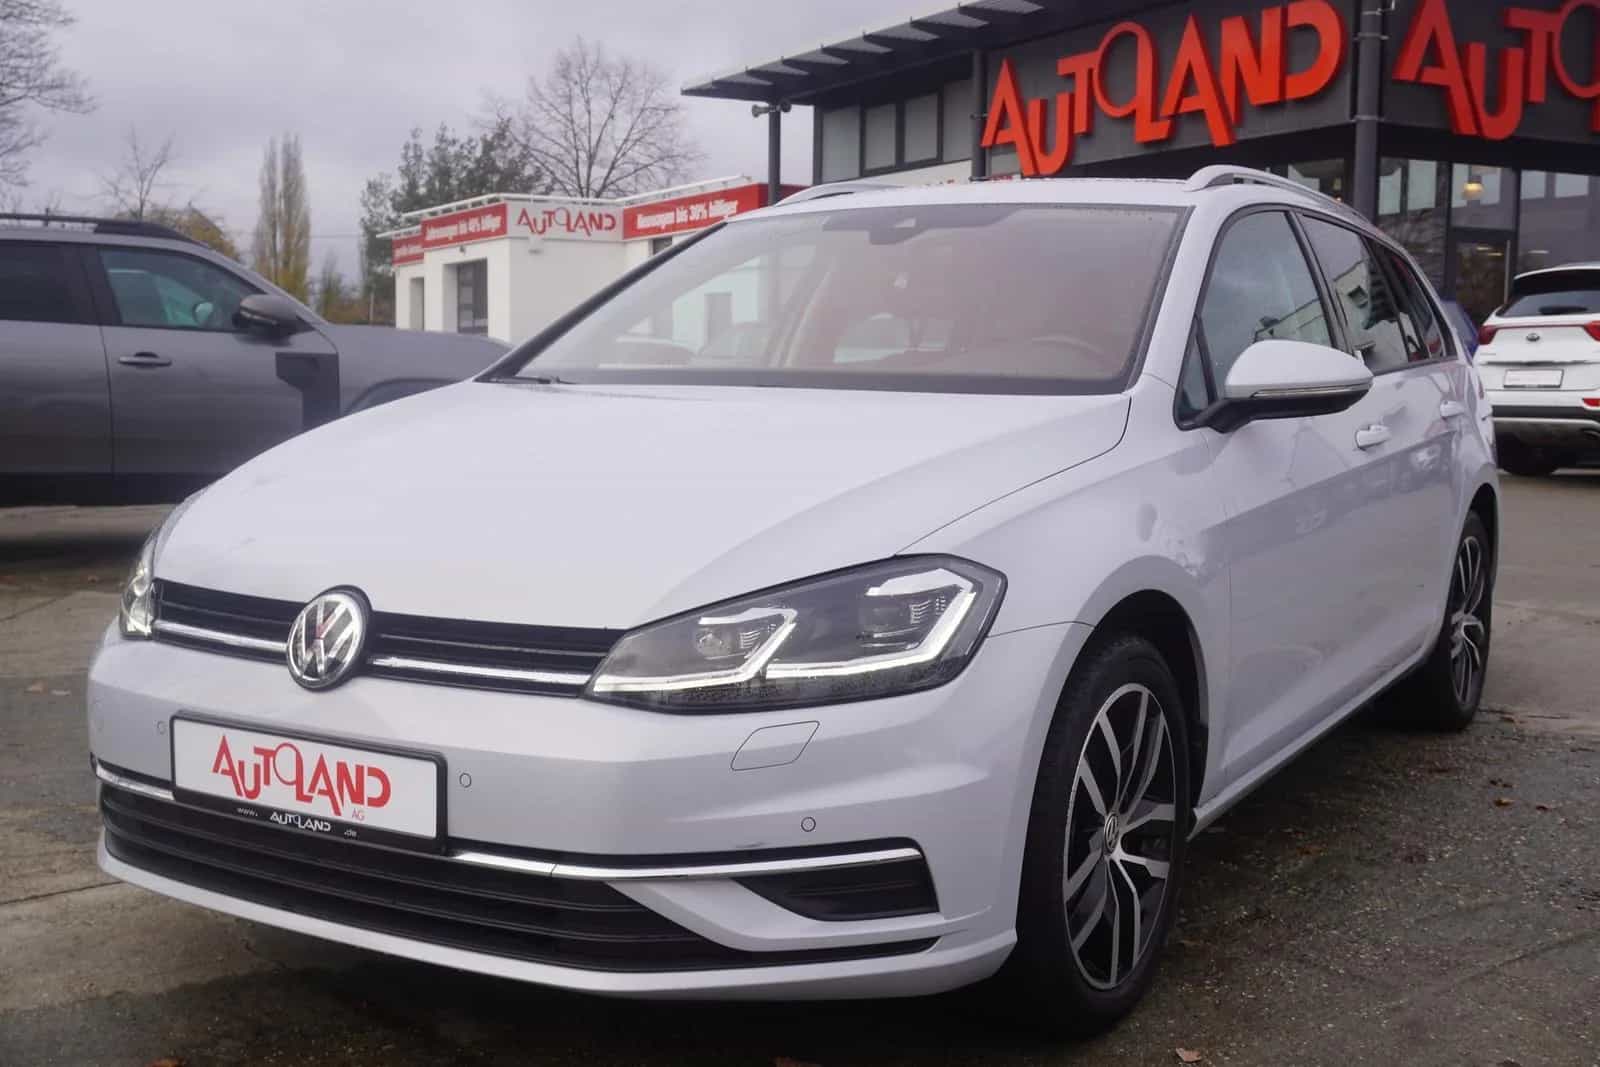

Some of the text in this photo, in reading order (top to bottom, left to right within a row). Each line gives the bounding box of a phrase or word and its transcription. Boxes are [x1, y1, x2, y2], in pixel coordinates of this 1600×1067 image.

[981, 0, 1344, 177] AUTOLAND
[1392, 0, 1600, 140] AUTO
[516, 206, 617, 237] AUTOLAND
[211, 734, 391, 816] AUTOLAND
[269, 810, 332, 831] AUTOLAND
[351, 807, 366, 821] AG
